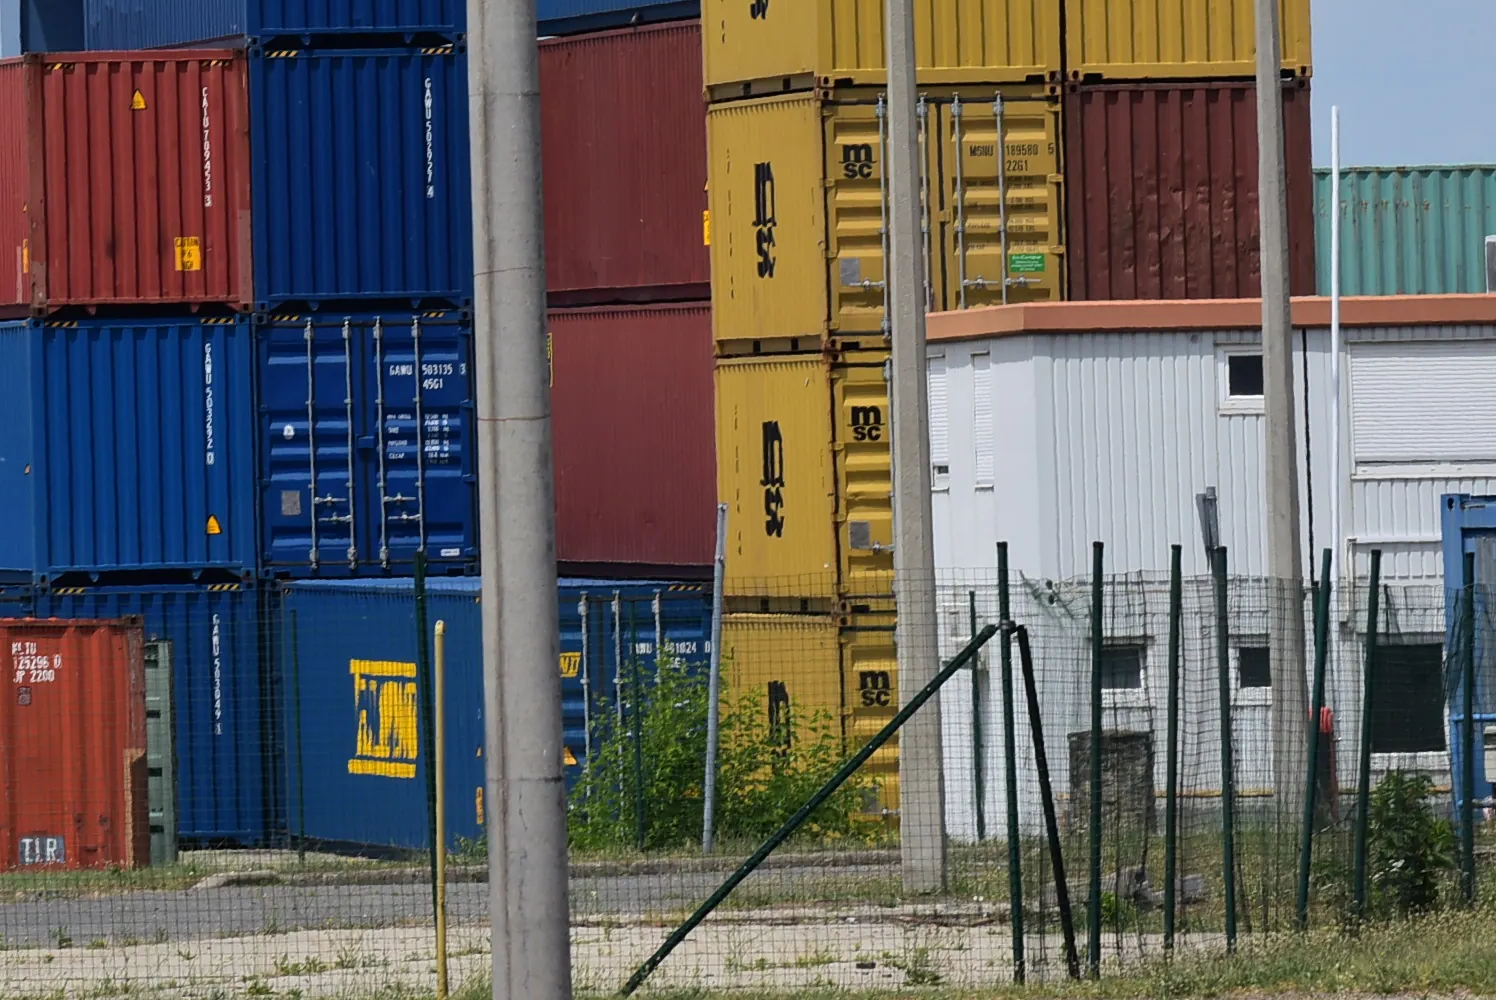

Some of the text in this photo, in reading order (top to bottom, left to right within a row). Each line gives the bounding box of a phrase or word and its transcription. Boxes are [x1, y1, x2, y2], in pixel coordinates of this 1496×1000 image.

[1005, 143, 1039, 157] 189580
[1006, 160, 1029, 172] 22G1
[422, 363, 453, 376] 503135
[423, 378, 444, 390] 45G1
[12, 655, 50, 670] 125296
[12, 669, 55, 684] JP 2200
